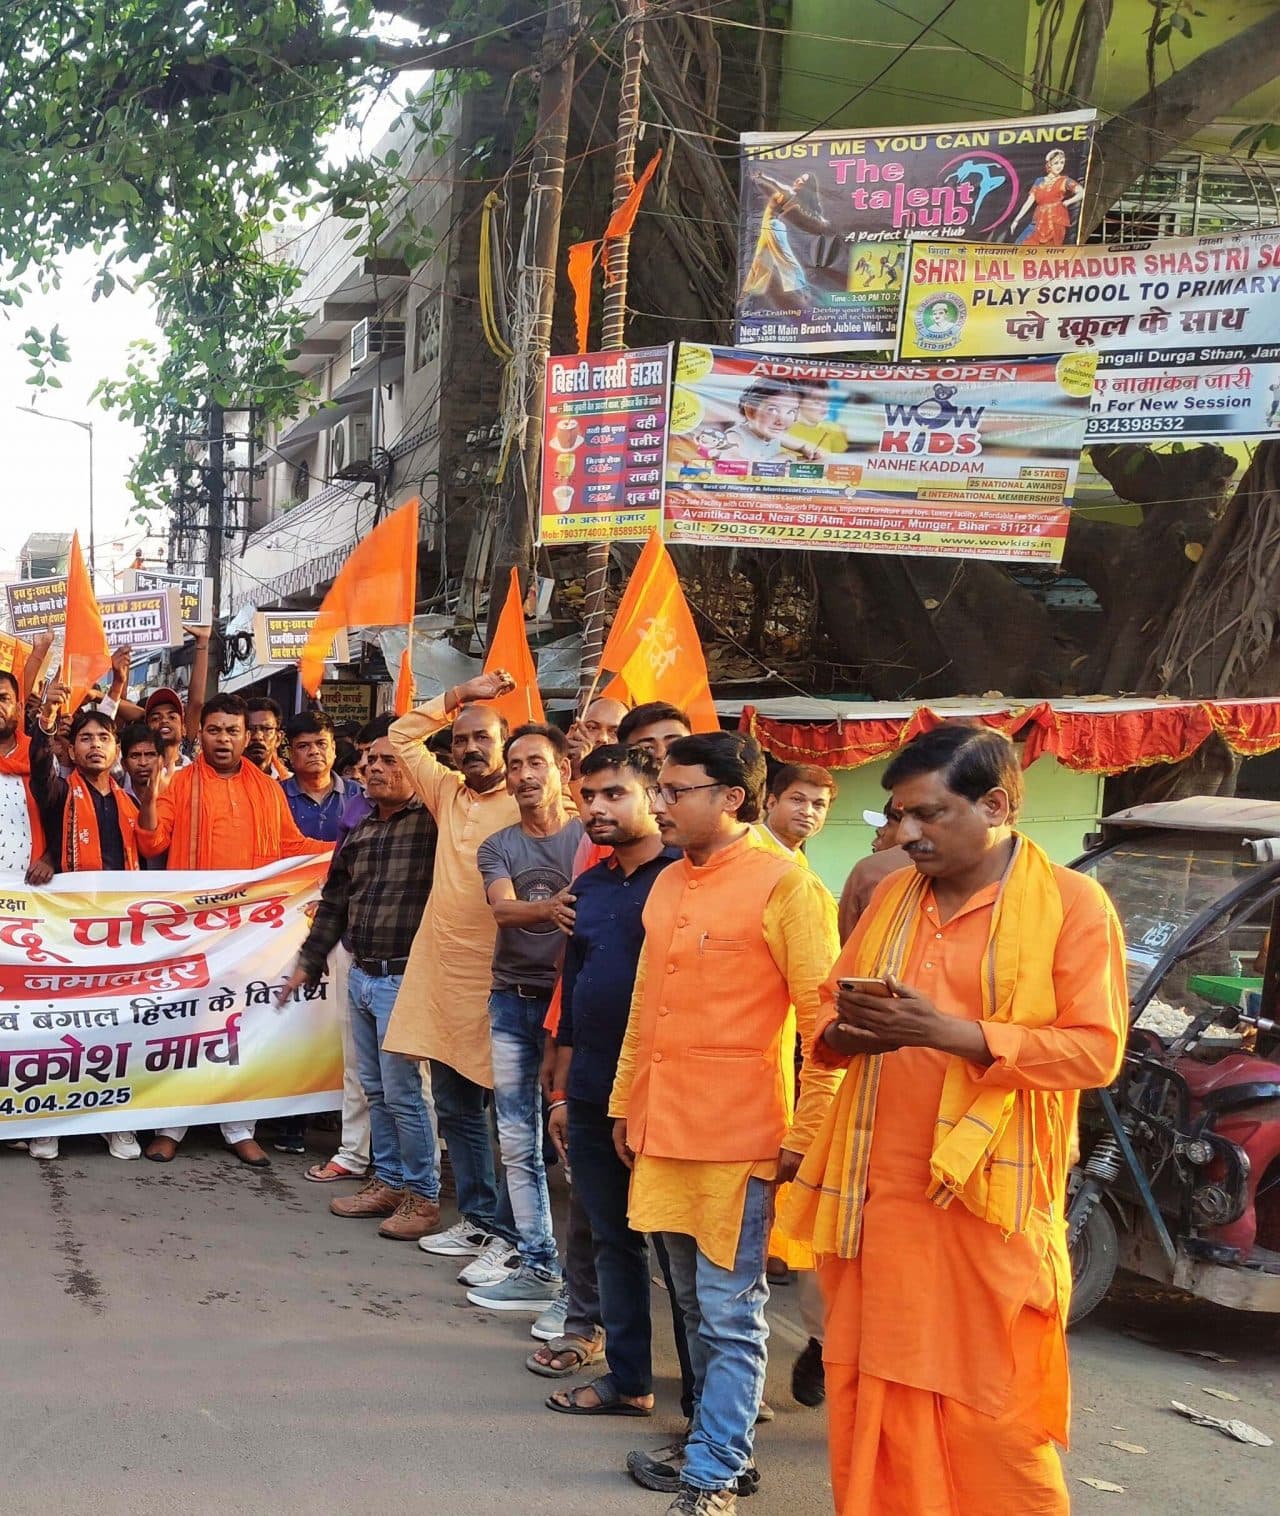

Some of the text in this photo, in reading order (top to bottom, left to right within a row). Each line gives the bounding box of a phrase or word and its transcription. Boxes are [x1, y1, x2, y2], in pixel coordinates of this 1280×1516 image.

[745, 125, 1088, 162] TRUST ME YOU CAN DANCE
[829, 159, 905, 185] The
[852, 182, 974, 210] talent
[893, 203, 969, 228] hub
[857, 229, 902, 243] Perfect
[940, 226, 966, 238] Hub
[913, 246, 1250, 285] SHRI LAL BAHADUR SHASTRI
[972, 275, 1280, 306] PLAY SCHOOL TO PRIMARY
[740, 326, 760, 336] Near
[777, 324, 799, 336] Main
[800, 323, 832, 335] Branch
[1005, 306, 1250, 346] प्ले स्कूल के साथ
[759, 355, 856, 370] An American
[1096, 348, 1247, 366] angali Durga Sthan,
[551, 361, 590, 395] बिहारी
[592, 357, 627, 390] लस्सी
[630, 360, 663, 387] हाउस
[748, 362, 930, 381] ADMISSIONS
[936, 365, 1018, 381] OPEN
[1111, 366, 1255, 395] नामांकन जारी
[884, 400, 986, 429] WOW
[1107, 399, 1135, 413] For
[1139, 397, 1178, 411] New
[1183, 395, 1252, 410] Session
[636, 414, 657, 430] दही
[1087, 417, 1185, 433] 934398532
[629, 433, 661, 447] पनीर
[879, 431, 979, 455] KIDS
[633, 451, 658, 464] पेड़ा
[867, 458, 985, 474] NANHE KADDAM
[1034, 470, 1066, 478] STATES
[981, 480, 1025, 489] NATIONAL
[1026, 482, 1063, 490] AWARDS
[928, 491, 996, 500] INTERNATIONAL
[997, 493, 1061, 503] MEMBERSHIPS
[615, 513, 646, 525] कुमार
[682, 508, 732, 521] Avantika
[733, 510, 766, 523] Road,
[768, 512, 795, 523] Near
[797, 513, 818, 524] SBI
[819, 515, 846, 526] Atm,
[848, 516, 905, 529] Jamalpur,
[907, 518, 955, 531] Munger,
[958, 521, 990, 532] Bihar
[999, 523, 1041, 534] 811214
[673, 521, 705, 533] Call:
[710, 523, 805, 537] 7903674712
[823, 529, 921, 542] 9122436134
[940, 537, 1052, 549] www.wowkids.in
[194, 887, 248, 906] संस्कार
[23, 960, 201, 992] जमालपुर
[30, 1003, 120, 1031] बंगाल
[129, 995, 200, 1026] हिंसा
[208, 985, 235, 1013] के
[145, 1012, 243, 1073] मार्च
